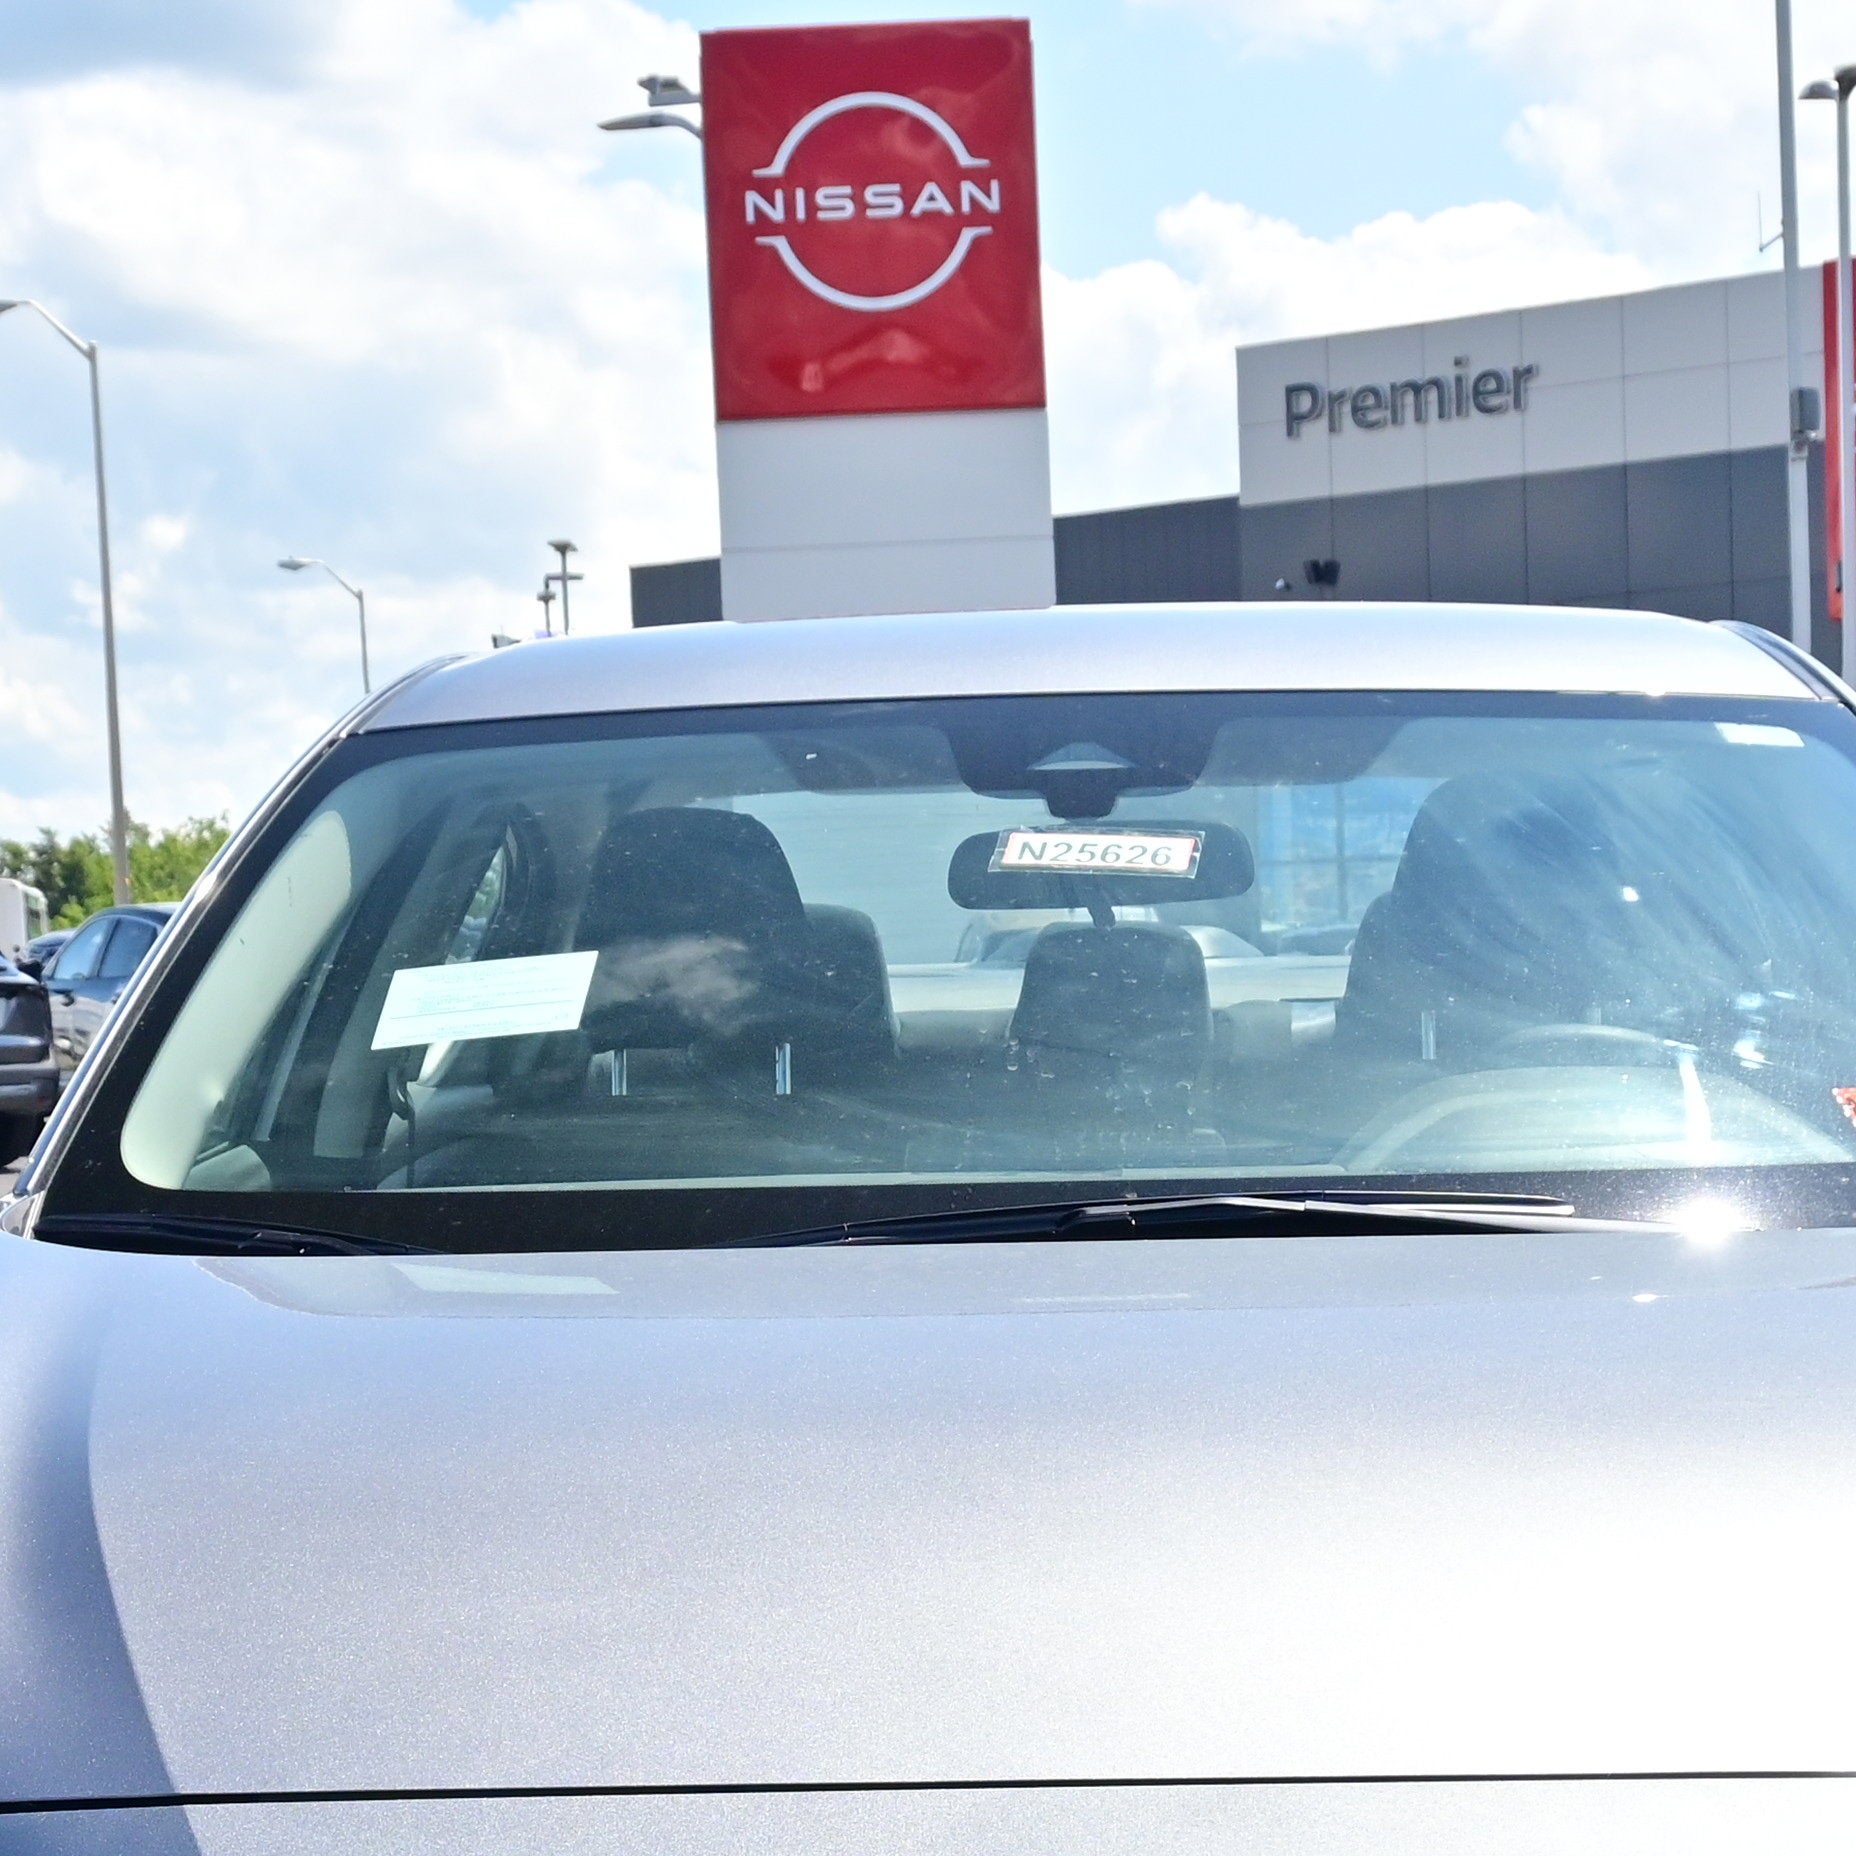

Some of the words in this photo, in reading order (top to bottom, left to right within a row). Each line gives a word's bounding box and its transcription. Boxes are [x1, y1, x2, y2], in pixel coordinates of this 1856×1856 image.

[743, 178, 1001, 224] NISSAN
[1284, 354, 1540, 438] Premier
[1017, 840, 1172, 866] N25626
